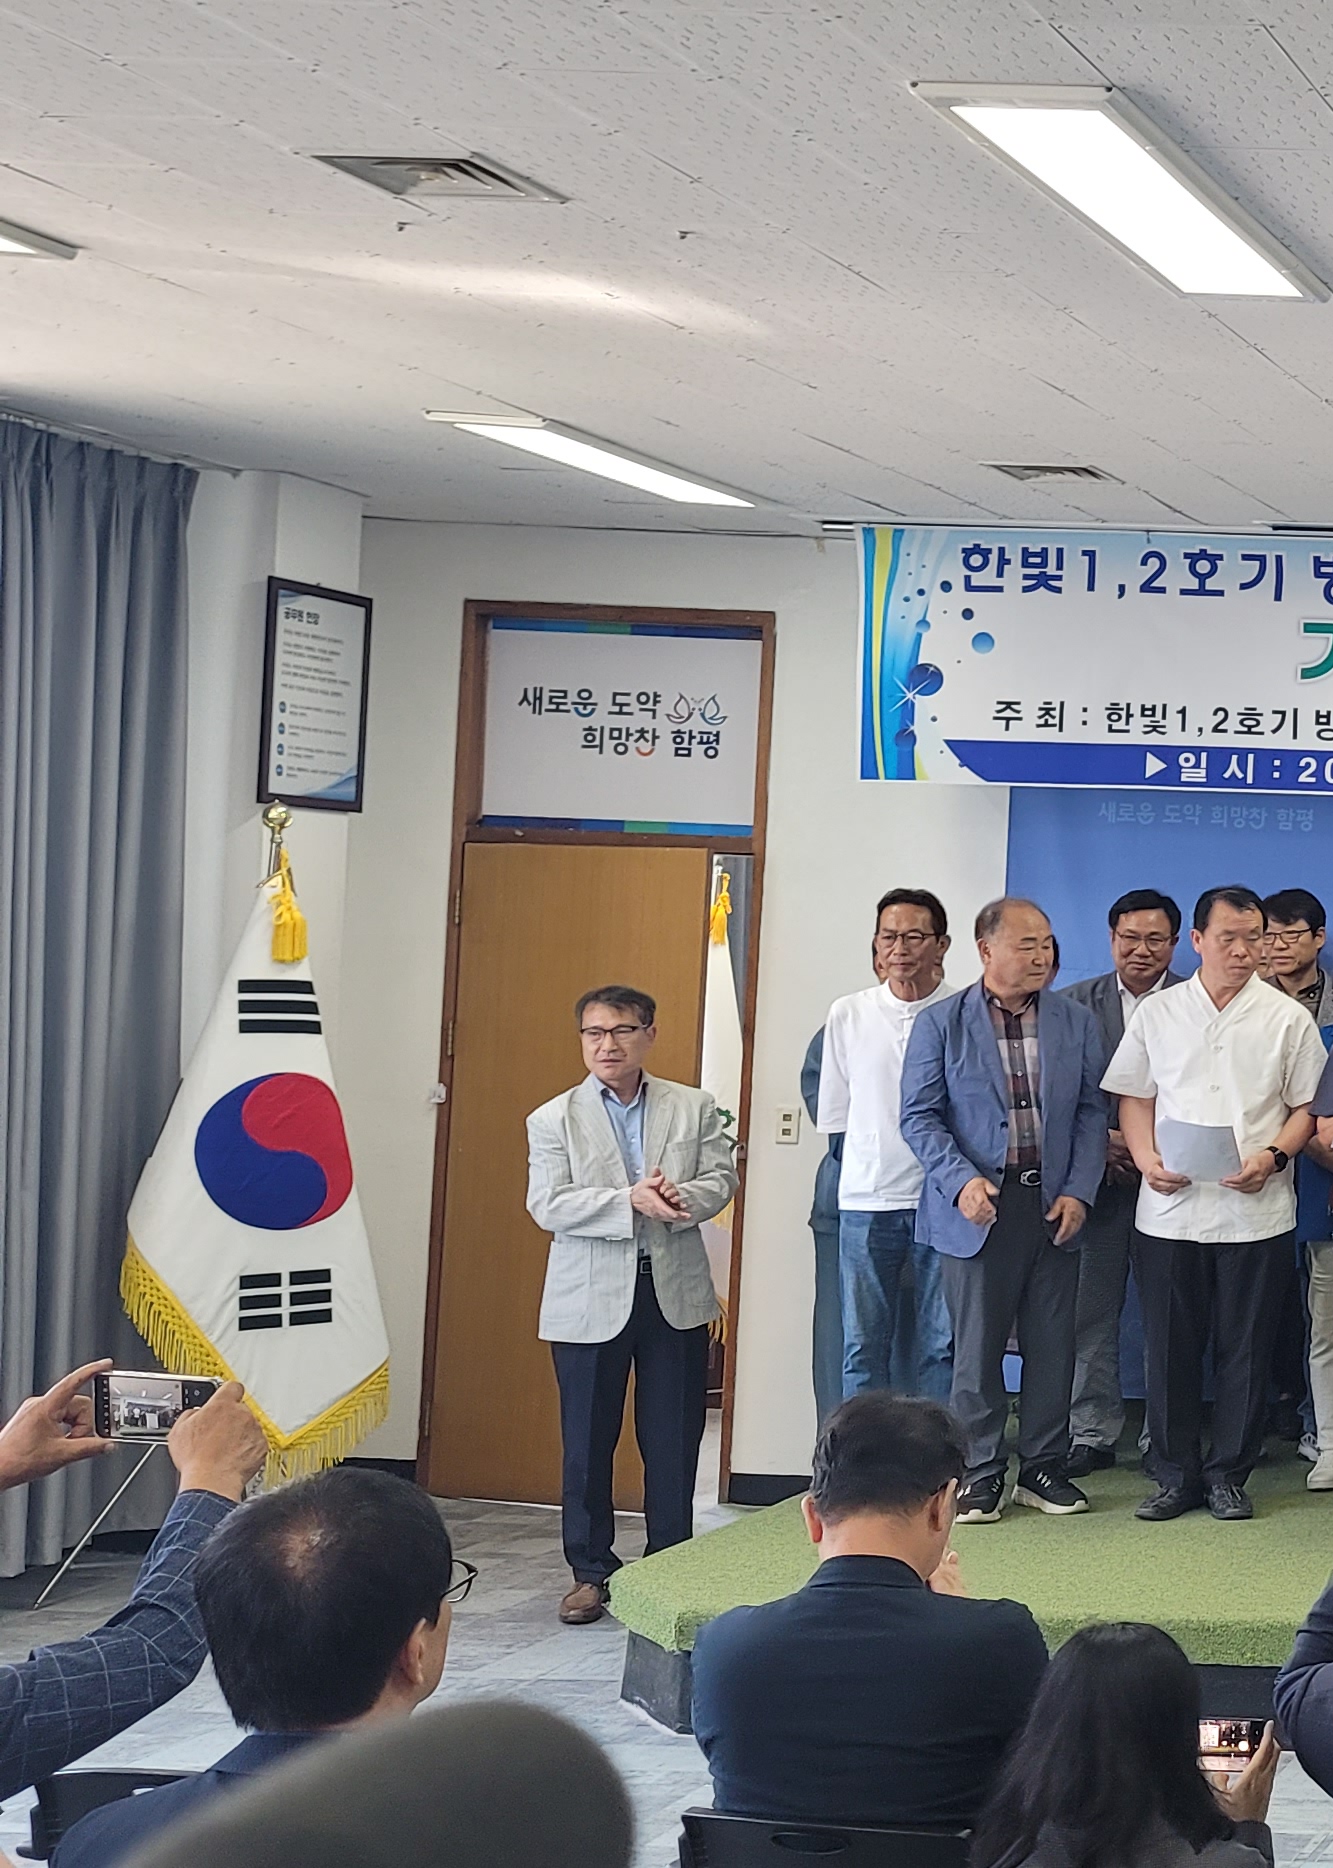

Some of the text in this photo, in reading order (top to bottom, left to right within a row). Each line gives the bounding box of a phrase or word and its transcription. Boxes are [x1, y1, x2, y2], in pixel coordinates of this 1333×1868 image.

[960, 543, 1284, 602] 한빛1,2호기
[518, 686, 661, 719] 새로운 도약
[1104, 702, 1299, 740] 한빛1,2호기
[580, 725, 721, 759] 희망찬 함평
[1099, 801, 1314, 832] 새로운 도약 희망찬 함평
